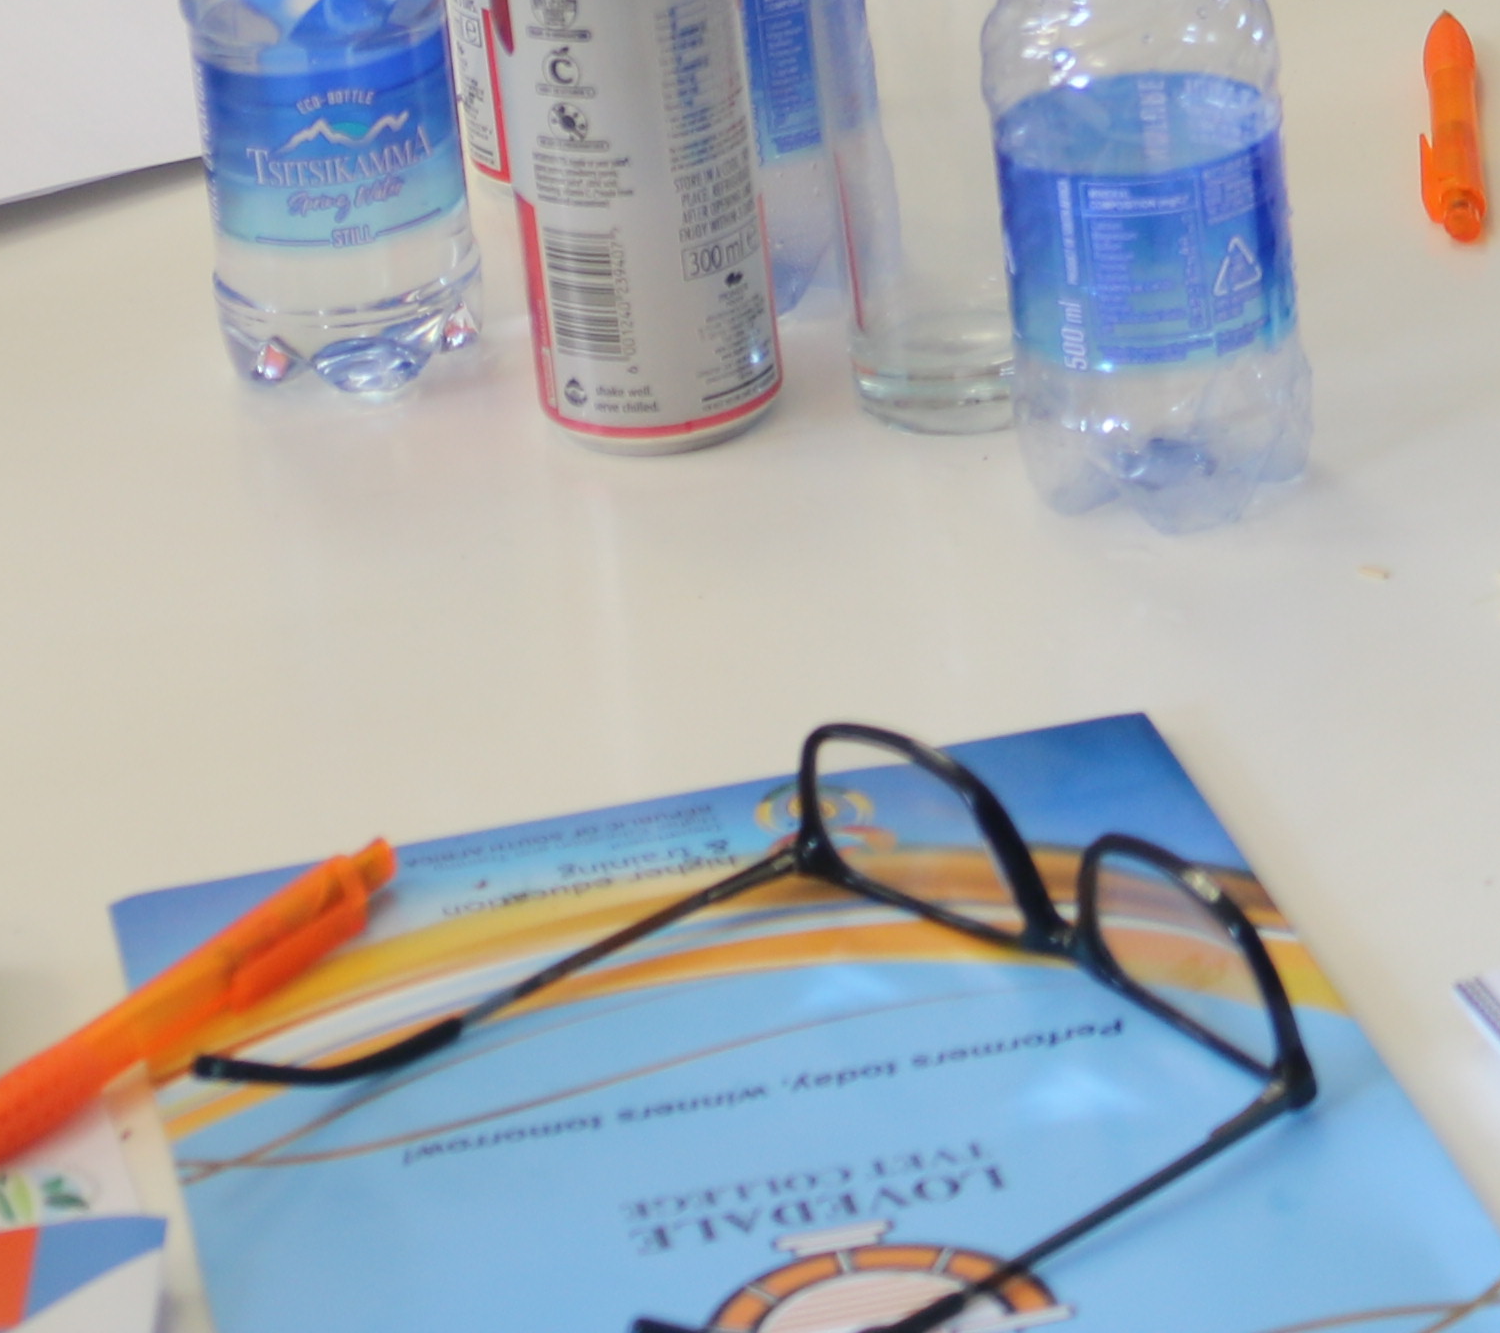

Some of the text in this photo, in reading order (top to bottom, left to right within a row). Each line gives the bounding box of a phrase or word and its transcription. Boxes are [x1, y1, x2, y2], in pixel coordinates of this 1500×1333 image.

[296, 88, 375, 115] ECO-BOTTLE
[246, 124, 435, 186] TSITSIKAMMA
[287, 173, 405, 223] Spring Water
[331, 224, 376, 248] STILL
[688, 233, 745, 277] 300 ml
[1057, 299, 1083, 324] ml
[1060, 329, 1088, 372] 500
[623, 400, 660, 414] chilled.
[402, 1017, 1126, 1166] Performers today, winners tomorrow!
[621, 1141, 990, 1220] TVET COLLEGE
[633, 1164, 1006, 1255] LOVEDALE
